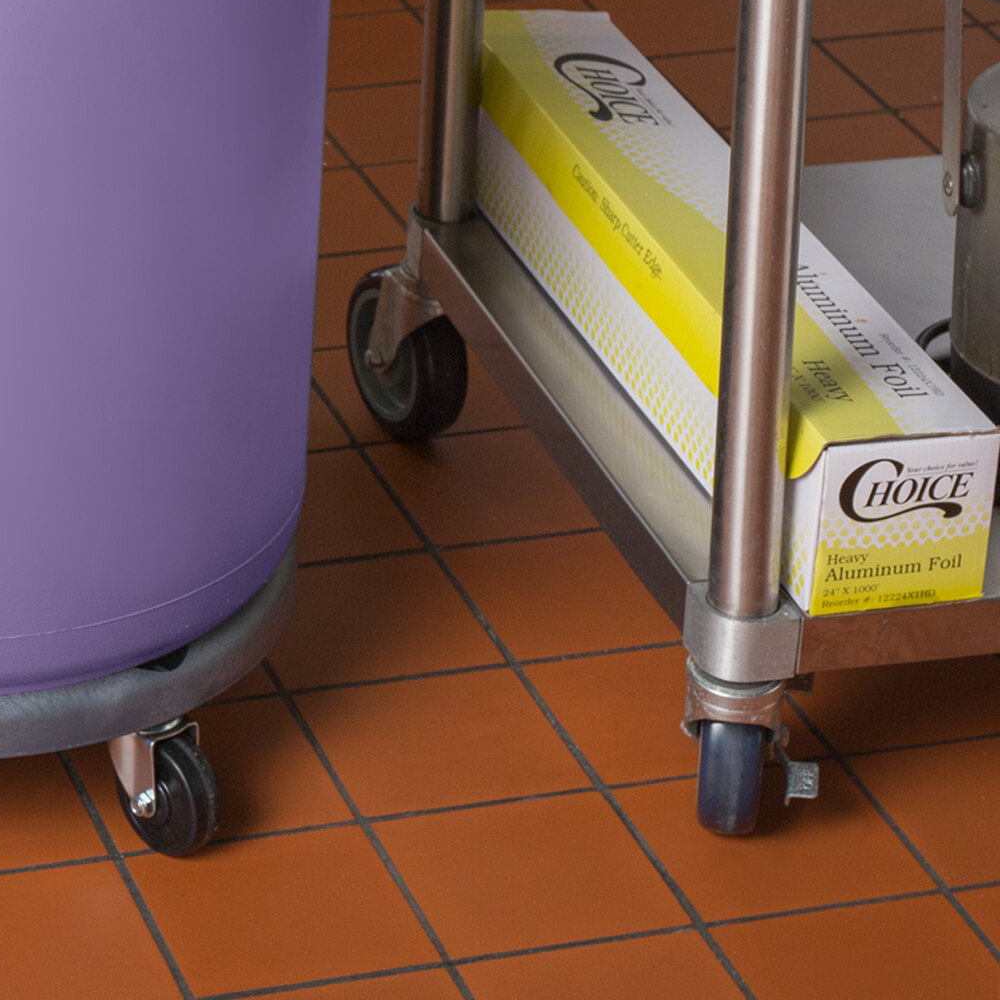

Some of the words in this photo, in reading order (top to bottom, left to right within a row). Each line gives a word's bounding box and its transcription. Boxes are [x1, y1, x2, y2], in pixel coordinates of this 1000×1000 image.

[554, 53, 660, 126] CHOICE
[572, 164, 600, 205] Caution:
[599, 197, 621, 232] Sharp
[621, 222, 644, 255] Cutter
[797, 263, 880, 357] luminum
[869, 362, 929, 398] Foil
[802, 359, 853, 402] Heavy
[923, 464, 945, 472] choice
[945, 462, 956, 472] for
[839, 458, 974, 523] CHOICE
[824, 561, 922, 582] Aluminum
[928, 554, 962, 571] Foil
[827, 553, 869, 566] Heavy
[821, 597, 860, 608] Reorder
[842, 586, 850, 595] X
